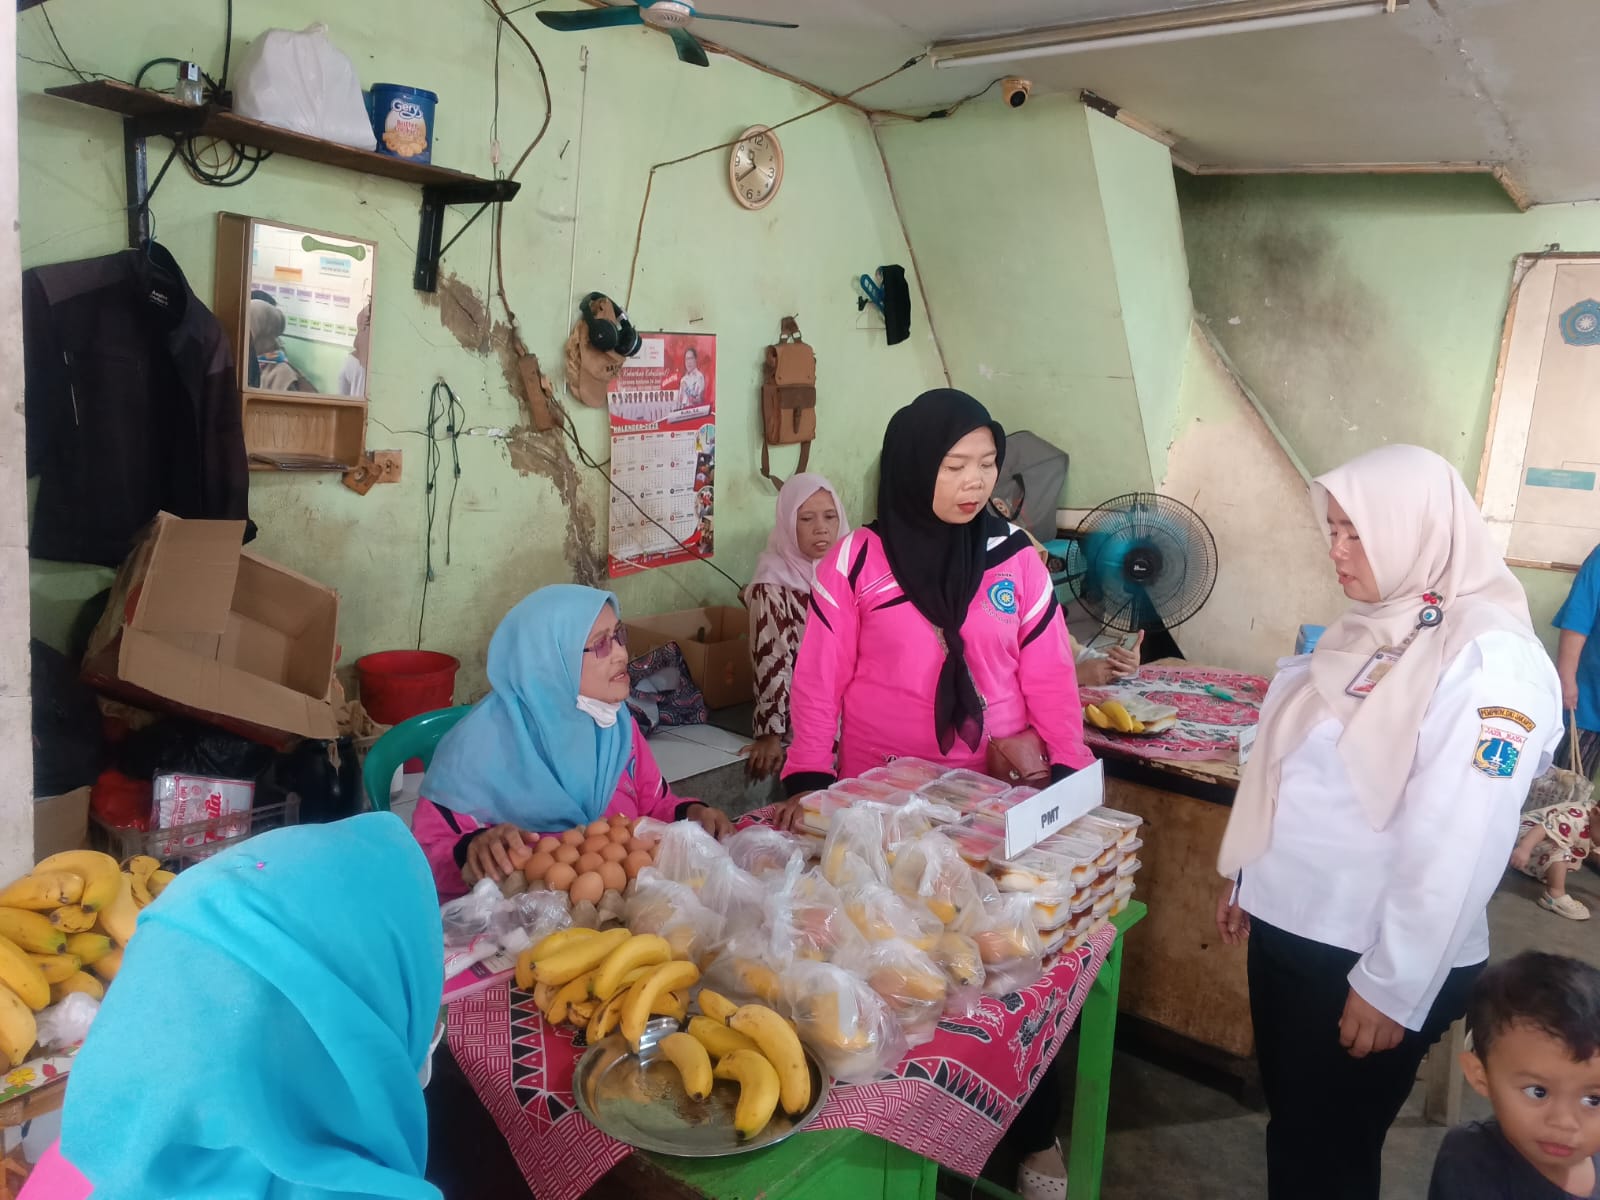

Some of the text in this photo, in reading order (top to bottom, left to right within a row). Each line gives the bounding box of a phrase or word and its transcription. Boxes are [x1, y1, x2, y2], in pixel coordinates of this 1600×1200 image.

[754, 134, 763, 146] 12
[767, 168, 775, 179] 3
[746, 188, 754, 200] 6
[1041, 806, 1059, 828] PMT
